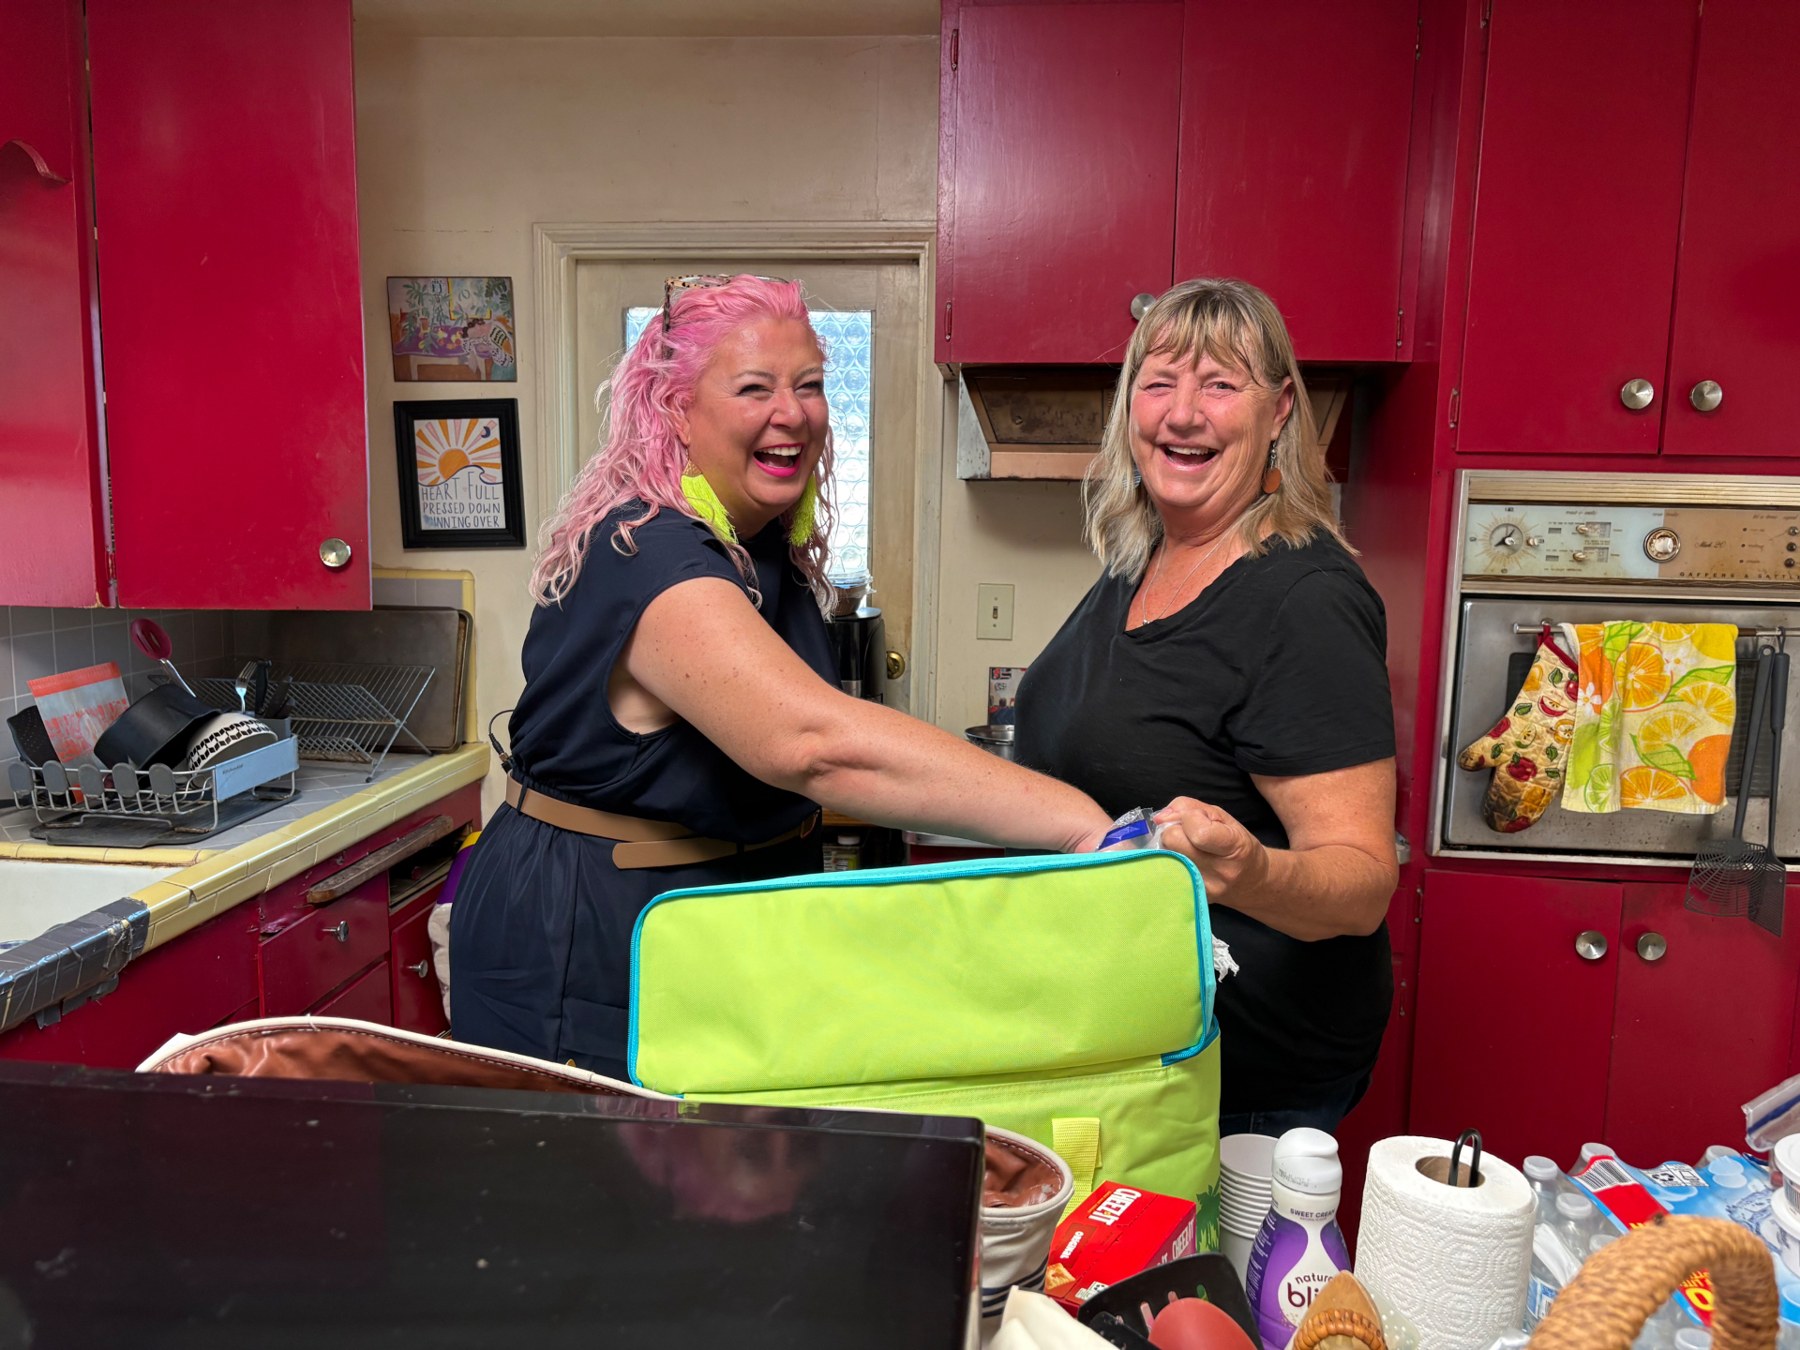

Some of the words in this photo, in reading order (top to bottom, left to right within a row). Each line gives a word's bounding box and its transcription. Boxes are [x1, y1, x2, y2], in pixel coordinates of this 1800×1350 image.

[421, 477, 460, 501] HEART
[467, 471, 500, 500] FULL
[422, 501, 465, 515] PRESSED
[468, 502, 501, 514] DOWN
[473, 516, 500, 528] OVER
[1290, 1207, 1314, 1218] SWEET
